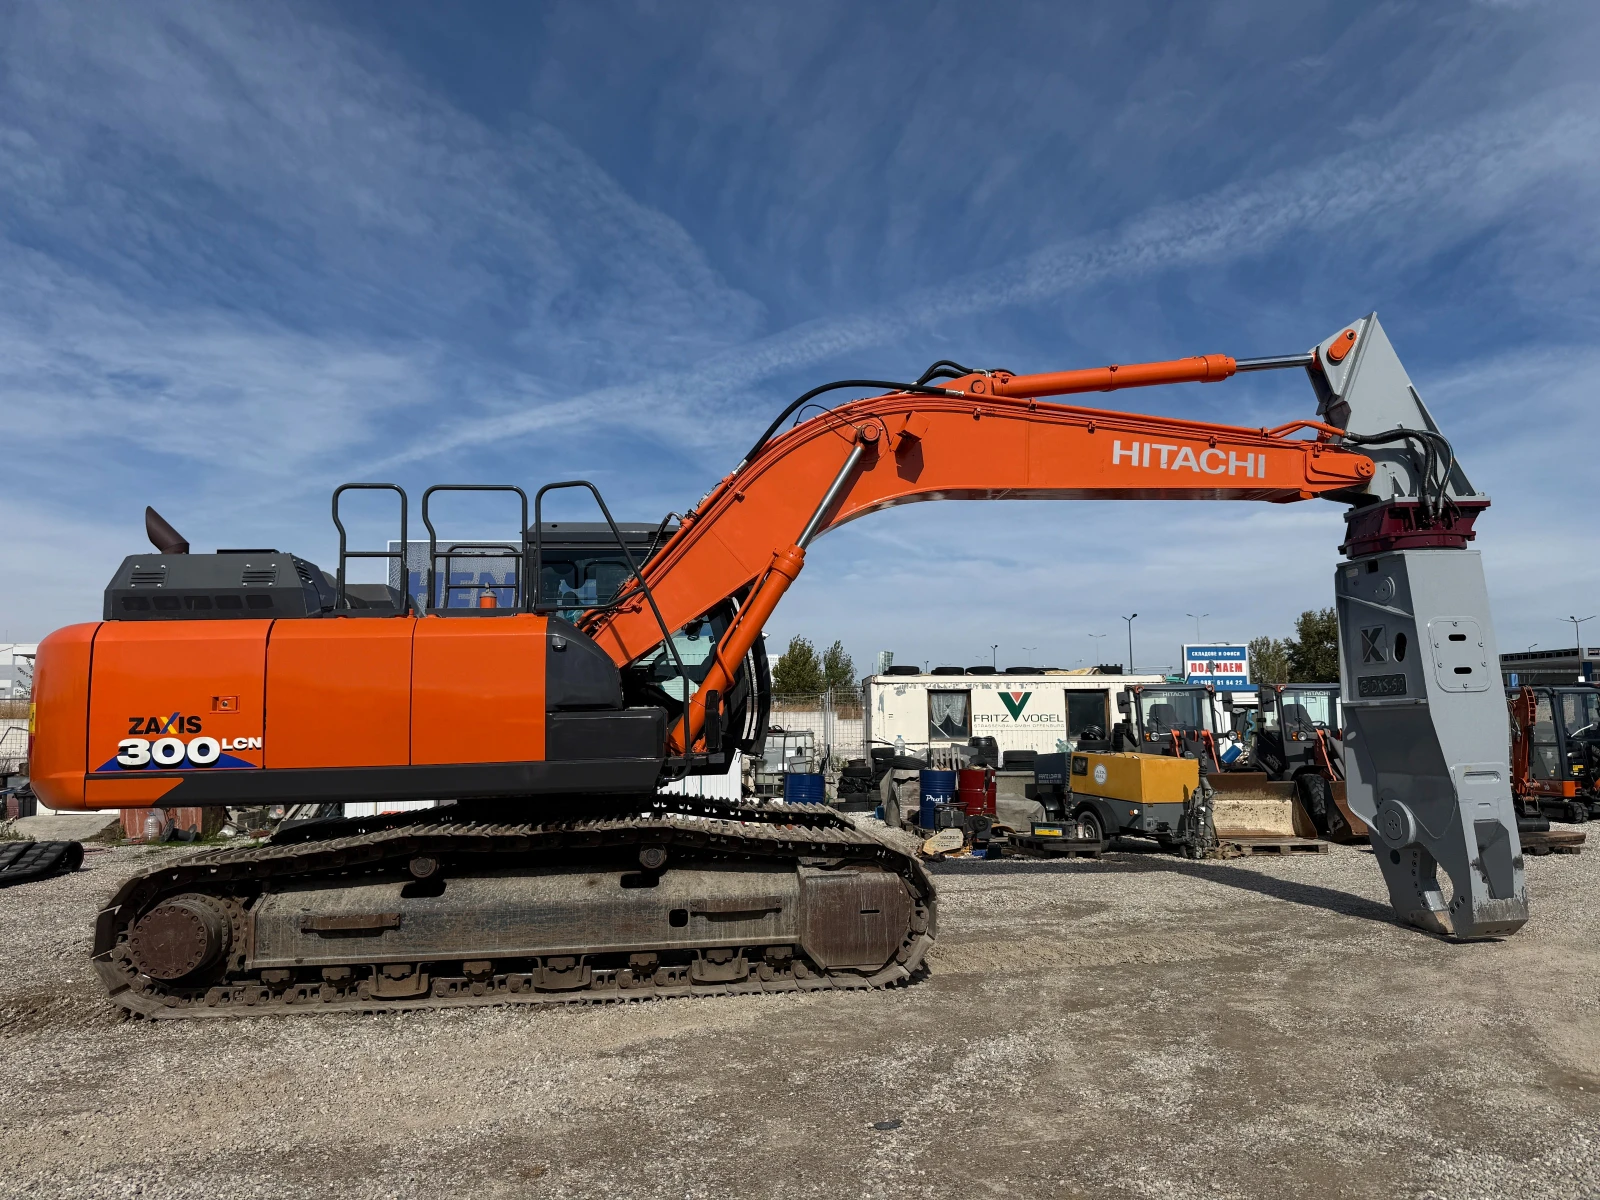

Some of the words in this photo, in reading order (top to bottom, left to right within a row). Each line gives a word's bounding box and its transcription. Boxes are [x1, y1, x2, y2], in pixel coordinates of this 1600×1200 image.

[1112, 439, 1266, 479] HITACHI
[1216, 663, 1243, 672] НАЕМ
[128, 712, 202, 735] ZAXIS
[973, 714, 1009, 722] FRITZ
[1022, 714, 1064, 722] VOGEL
[116, 737, 221, 769] 300
[221, 737, 262, 751] LCN
